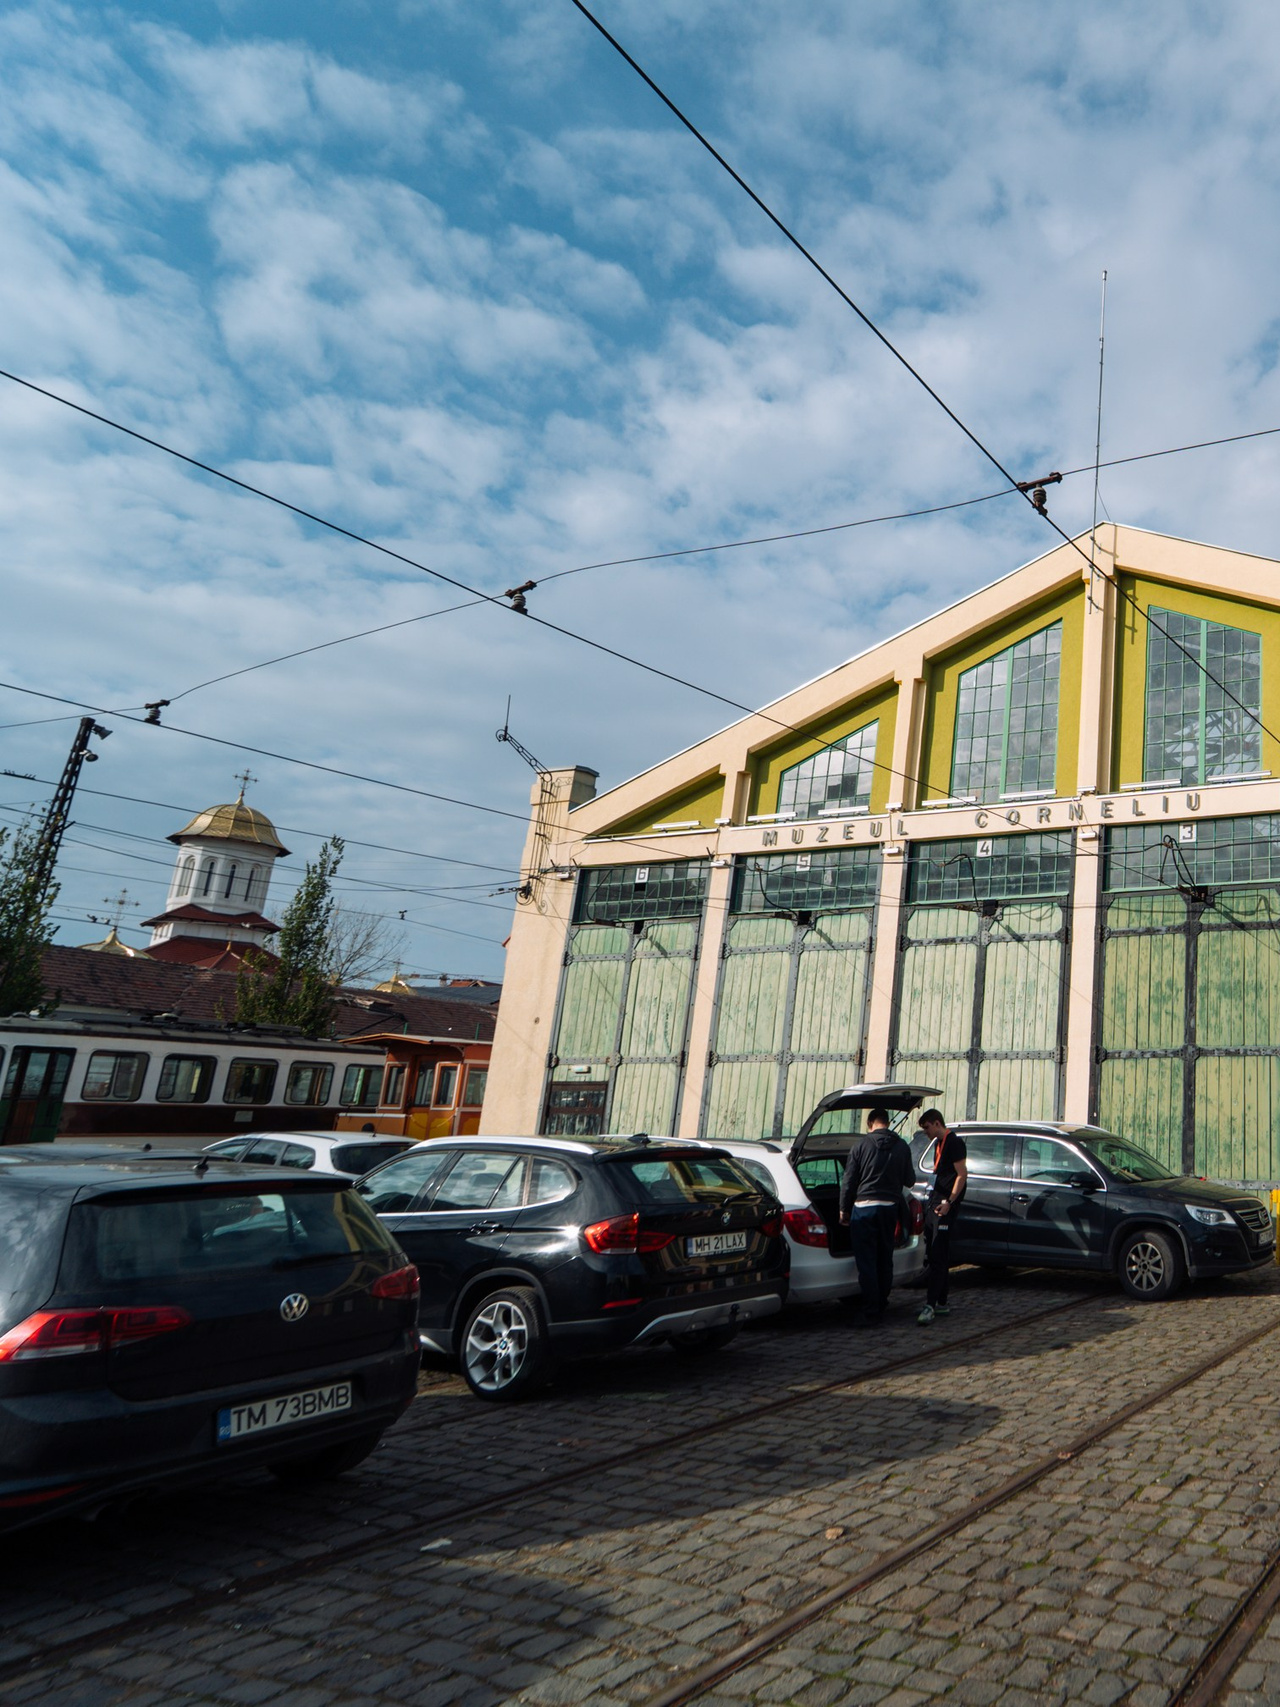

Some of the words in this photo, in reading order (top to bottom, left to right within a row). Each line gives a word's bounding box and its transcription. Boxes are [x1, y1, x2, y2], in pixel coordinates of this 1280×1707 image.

[762, 819, 909, 847] MUZEUL
[974, 792, 1201, 829] CORNELIU
[1182, 823, 1194, 840] 3
[979, 840, 990, 856] 4
[799, 853, 809, 869] 5
[637, 866, 647, 881] 6
[695, 1237, 711, 1253] MH
[714, 1236, 724, 1250] 21
[726, 1233, 745, 1249] LAX
[280, 1292, 309, 1322] VW
[232, 1403, 267, 1433] TM
[274, 1384, 350, 1424] 73BMB
